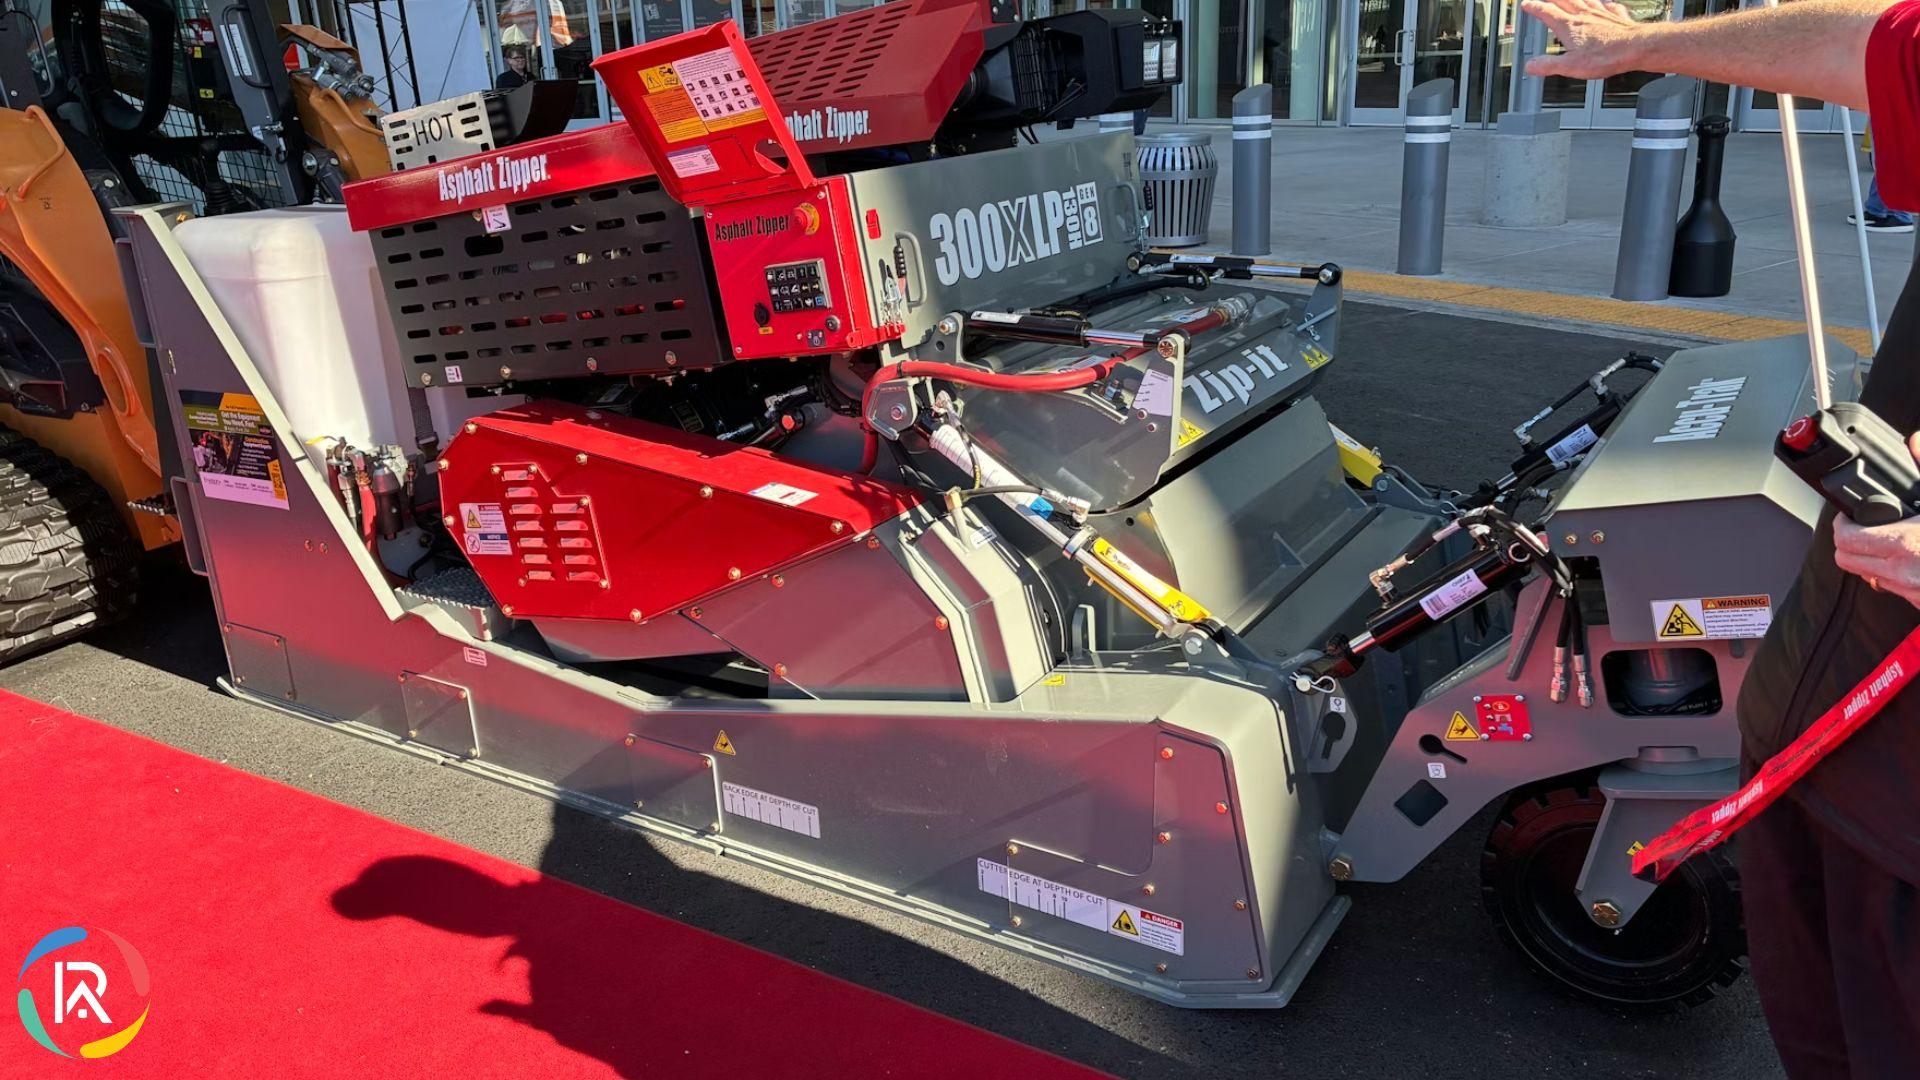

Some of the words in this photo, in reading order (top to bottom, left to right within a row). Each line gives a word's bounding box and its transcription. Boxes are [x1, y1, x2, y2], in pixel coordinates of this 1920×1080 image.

[412, 113, 455, 146] HOT
[826, 106, 869, 144] Zipper
[438, 162, 495, 205] Asphalt
[496, 154, 547, 194] Zipper
[1079, 186, 1095, 200] GEN
[715, 219, 753, 243] Asphalt
[755, 214, 790, 237] Zipper
[1083, 205, 1098, 237] 8
[930, 190, 1065, 286] 300XLP
[1182, 344, 1289, 414] Zip-it
[1718, 598, 1765, 607] WARNING
[1871, 660, 1904, 698] Asphalt
[1843, 694, 1870, 720] Zipper
[741, 788, 758, 799] EDGE
[769, 796, 791, 809] DEPTH
[802, 806, 816, 816] CUT
[1009, 870, 1031, 884] EDGE
[1032, 877, 1042, 888] AT
[1043, 880, 1071, 896] DEPTH
[1073, 890, 1085, 899] OF
[1086, 894, 1104, 905] CUT
[1152, 915, 1179, 928] DANGER
